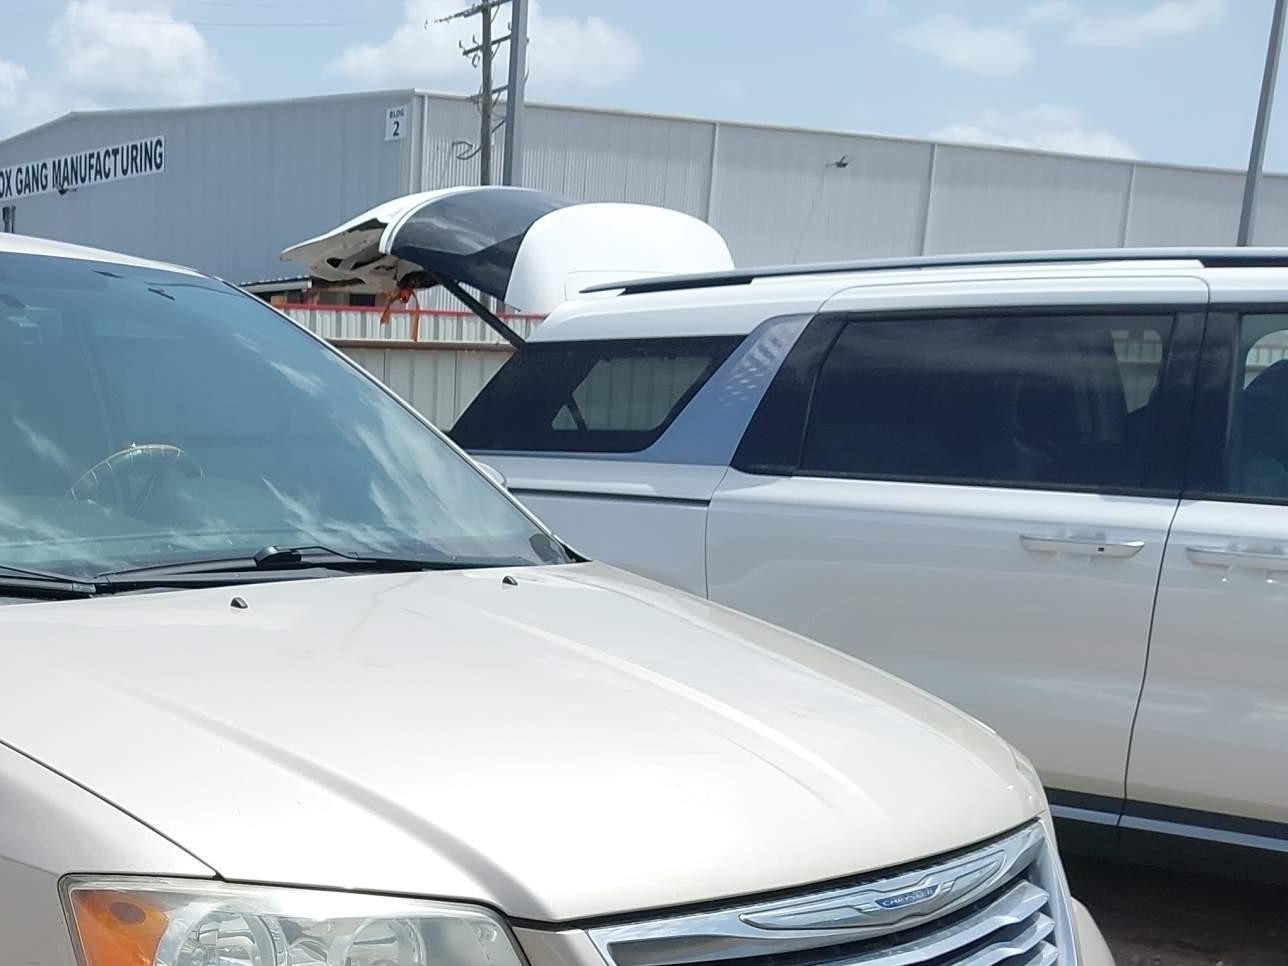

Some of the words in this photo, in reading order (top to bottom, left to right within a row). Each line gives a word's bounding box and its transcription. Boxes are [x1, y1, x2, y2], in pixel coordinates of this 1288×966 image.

[392, 120, 400, 137] 2
[15, 162, 48, 196] GANG
[52, 139, 163, 189] MANUFACTURING
